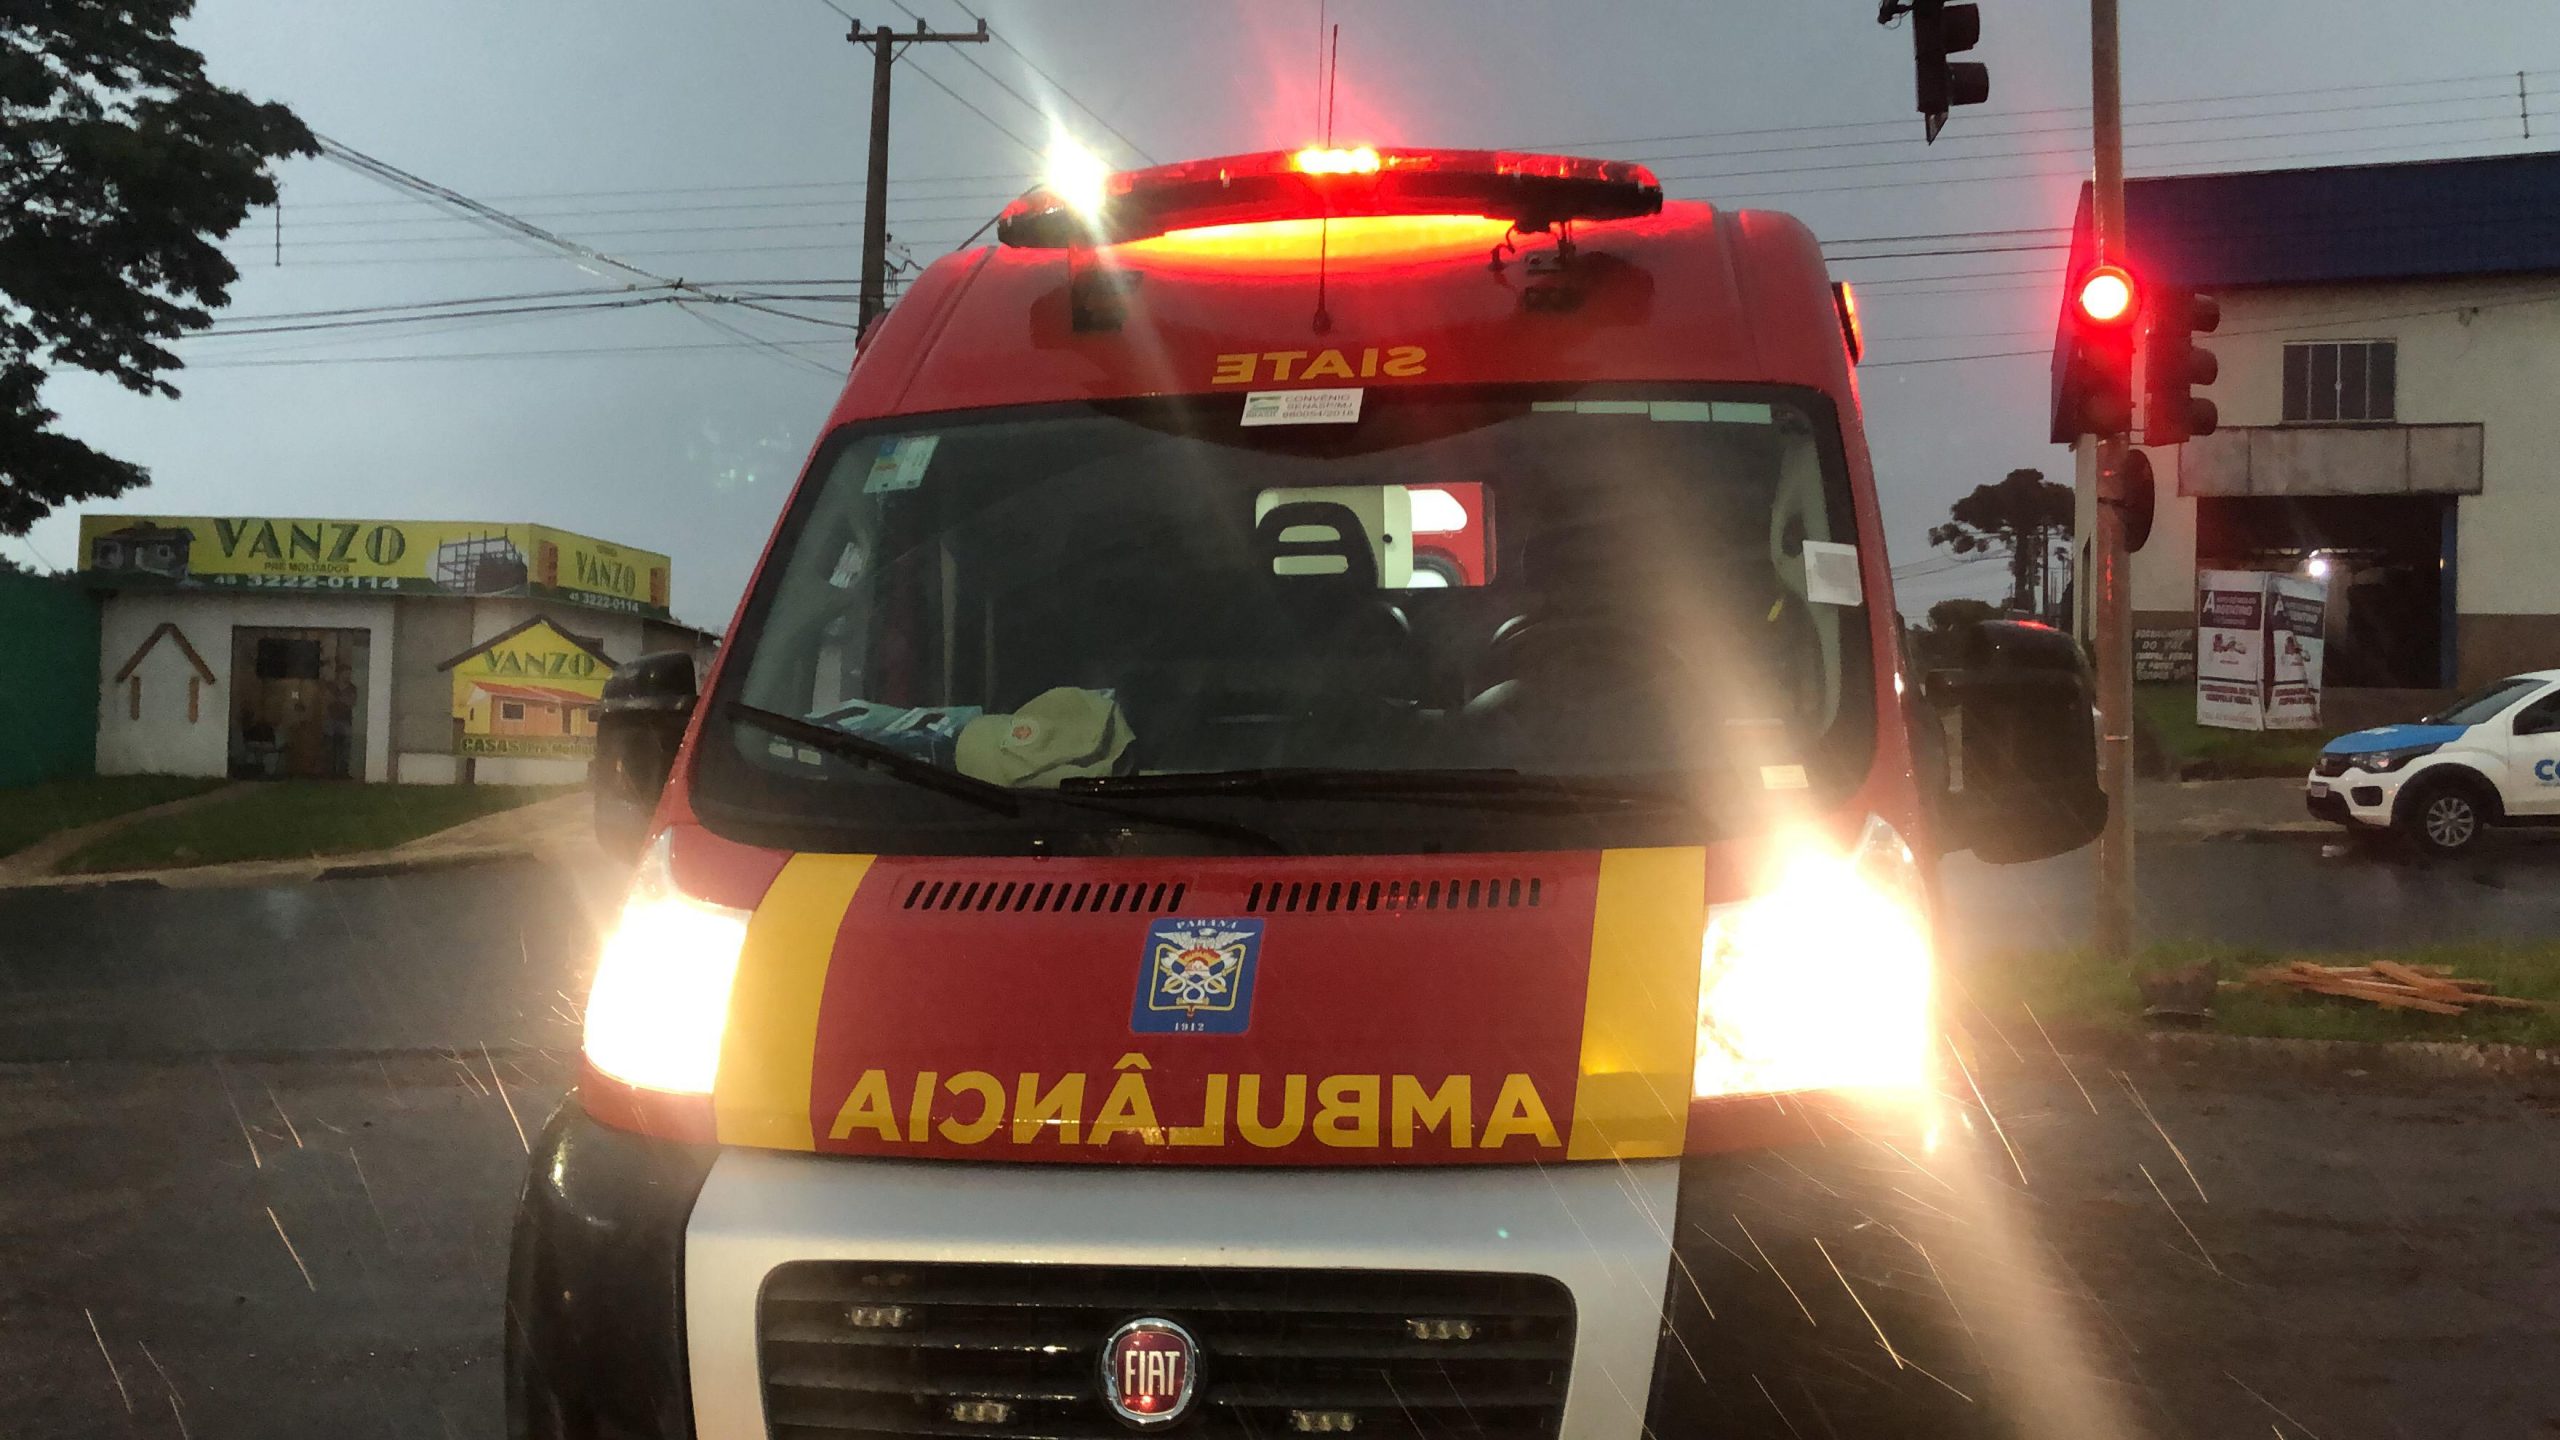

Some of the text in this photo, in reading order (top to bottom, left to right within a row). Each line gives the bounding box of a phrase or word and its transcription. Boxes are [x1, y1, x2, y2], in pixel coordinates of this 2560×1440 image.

[213, 518, 406, 566] VANZO
[289, 562, 350, 573] MOLDADOS
[576, 551, 636, 596] VANZO
[247, 576, 400, 590] 3222-0114
[483, 650, 596, 677] VANZO
[461, 738, 520, 753] CASAS
[2534, 759, 2560, 781] C
[1174, 1022, 1205, 1031] 1912
[1125, 1350, 1181, 1396] FIAT
